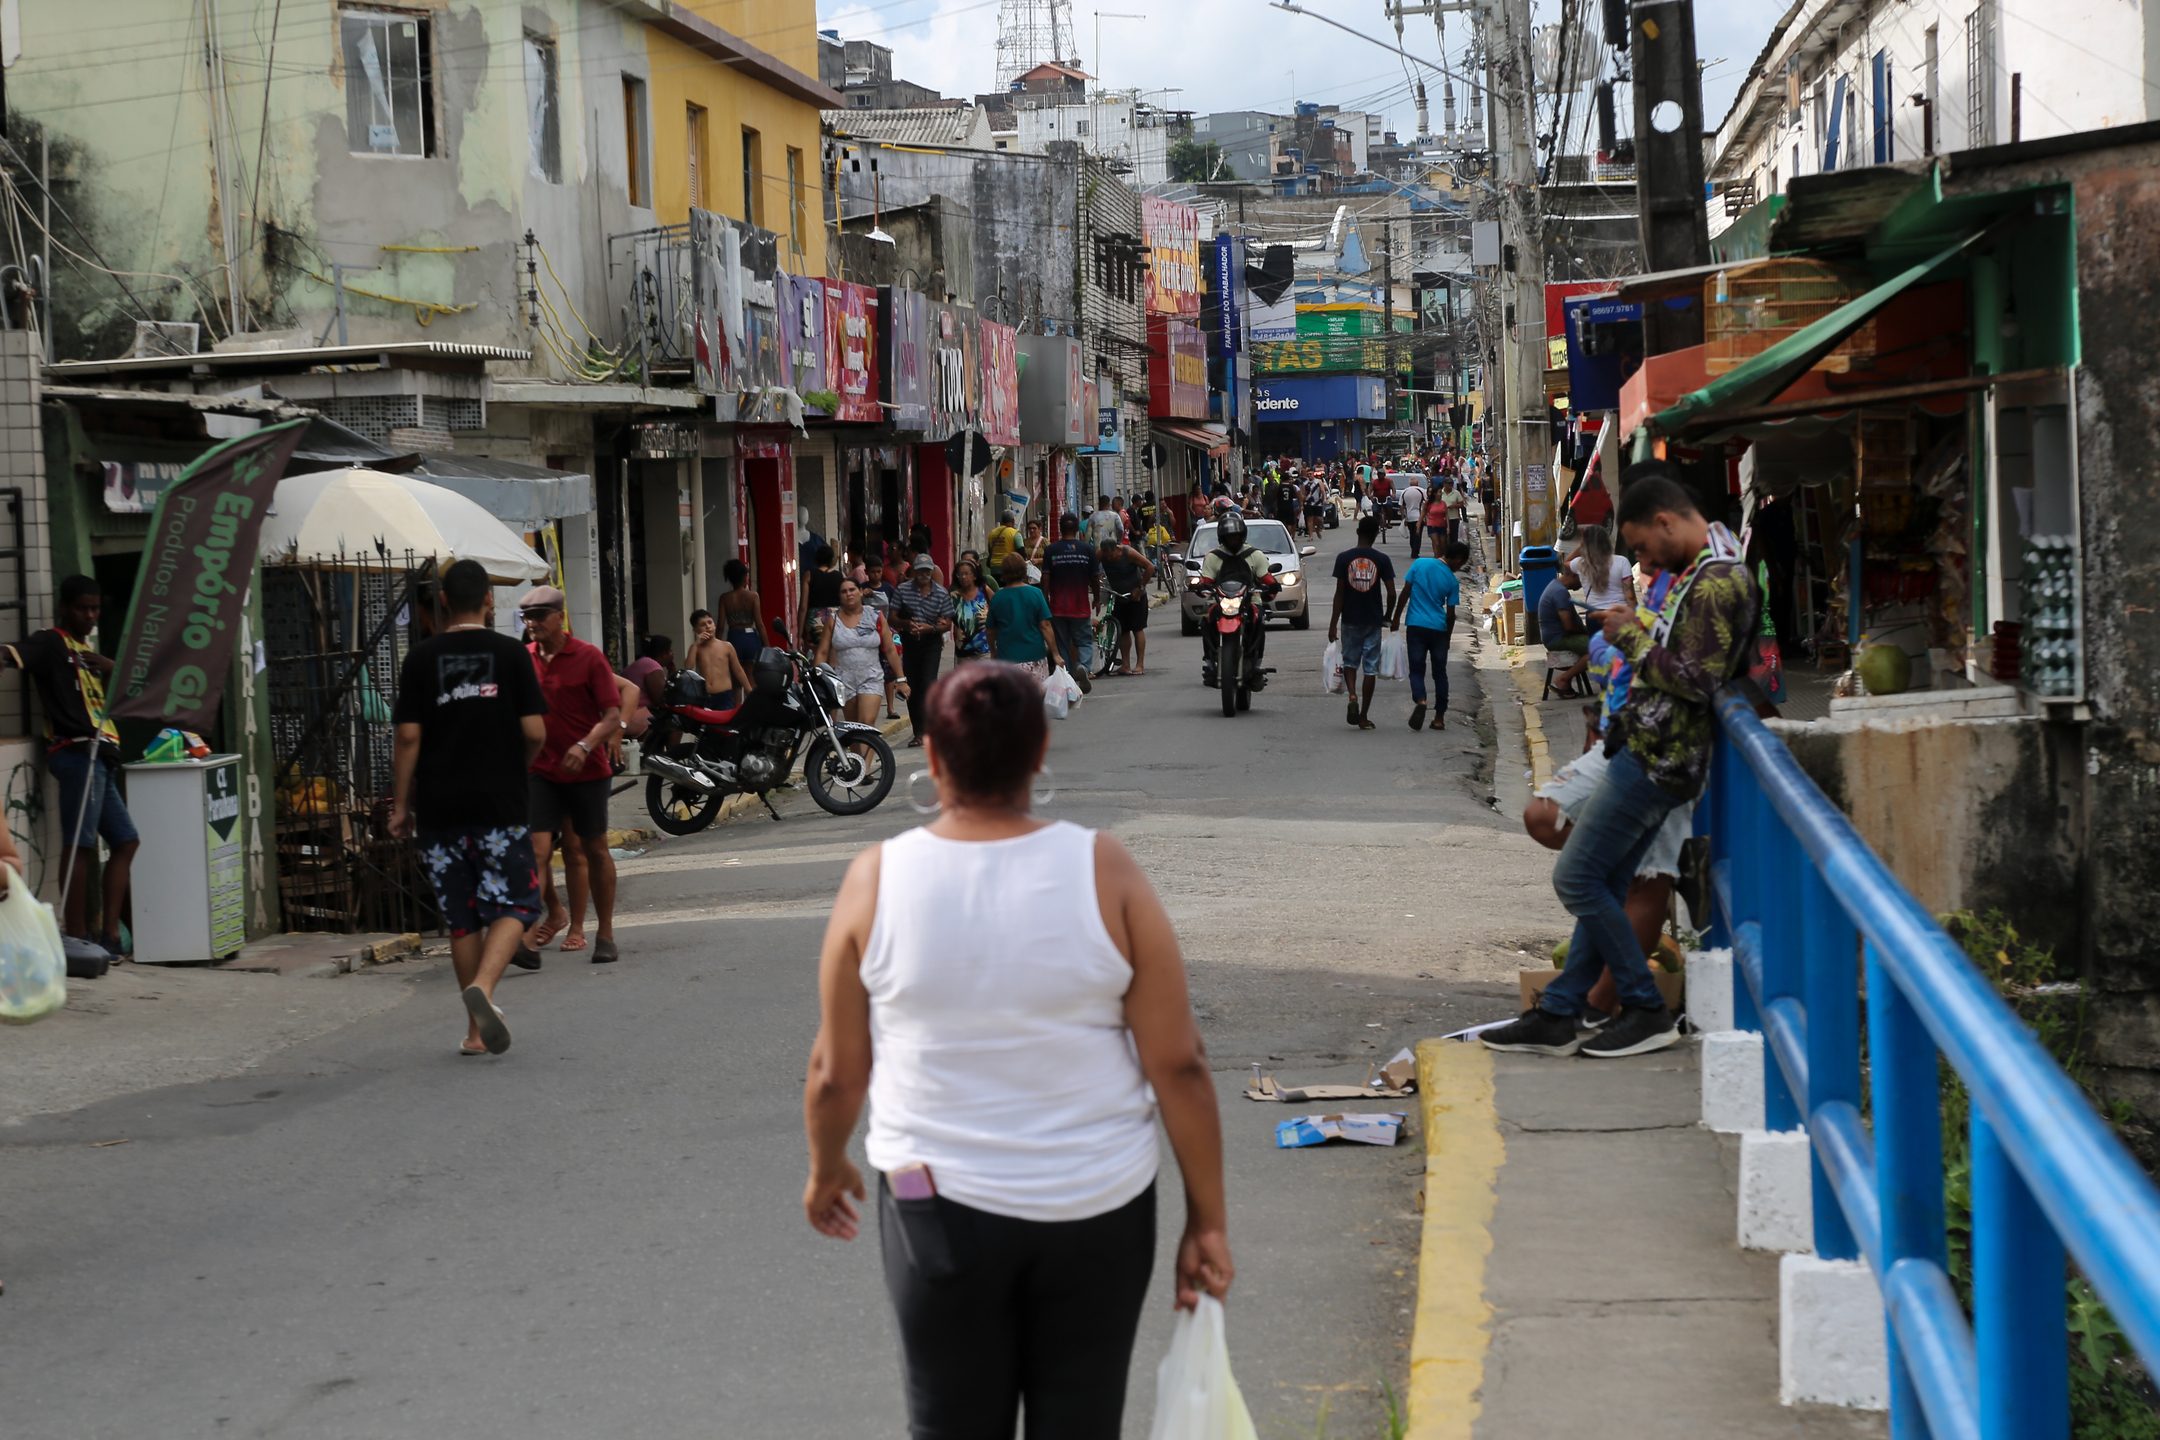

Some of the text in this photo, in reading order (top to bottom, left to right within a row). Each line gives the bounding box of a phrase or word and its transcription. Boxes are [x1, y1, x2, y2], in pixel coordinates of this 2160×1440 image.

[1221, 246, 1229, 299] TRABALHADOR
[1264, 340, 1323, 370] TAS
[1256, 397, 1299, 411] ndente
[152, 496, 197, 596] Produtos
[126, 603, 169, 698] Naturais
[163, 491, 254, 717] Empório GL
[240, 587, 268, 930] ARAIBANA
